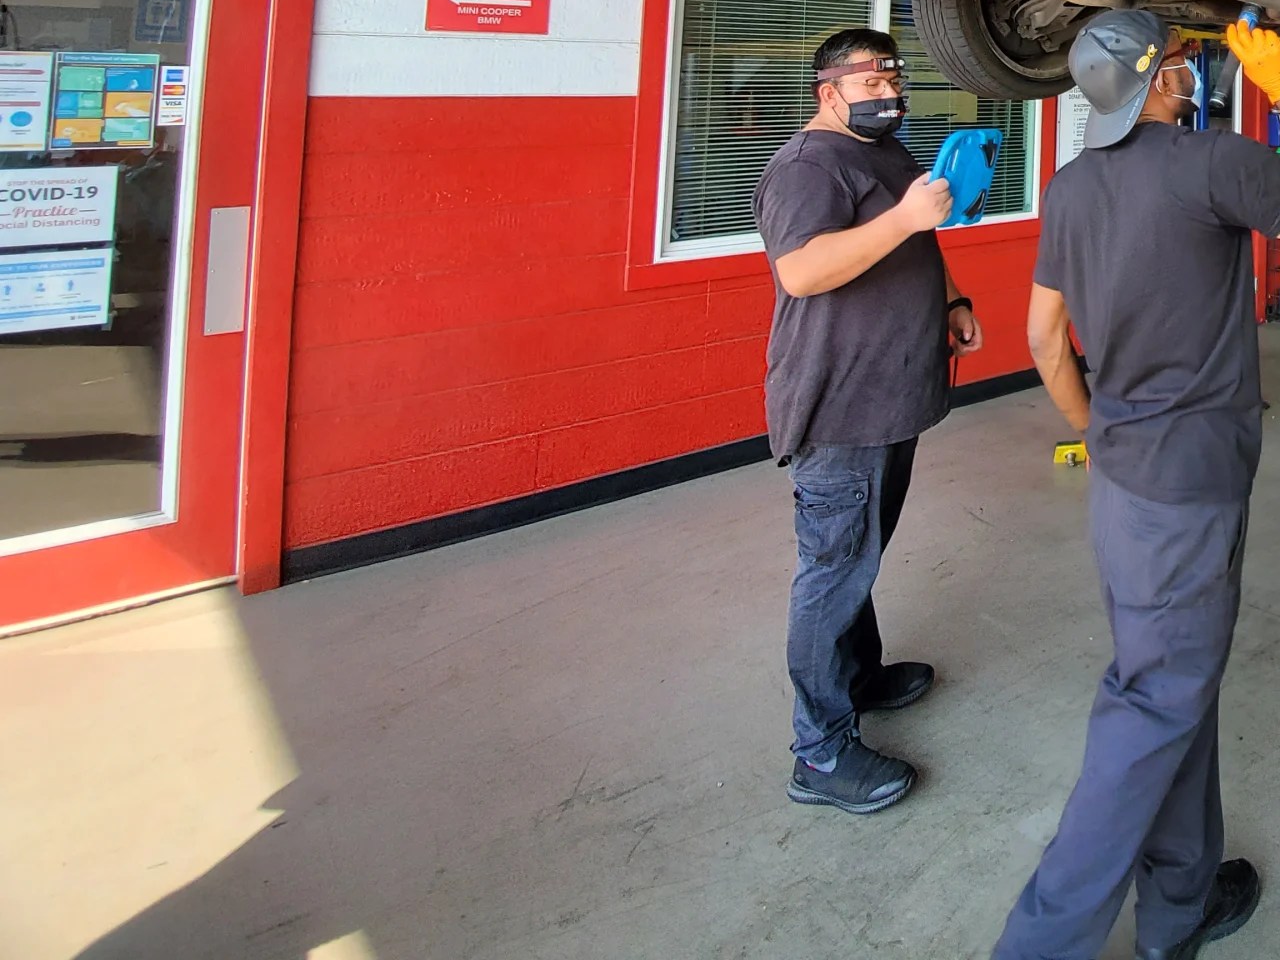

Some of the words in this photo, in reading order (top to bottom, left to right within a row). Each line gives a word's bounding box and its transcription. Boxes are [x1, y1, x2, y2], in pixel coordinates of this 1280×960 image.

[457, 7, 479, 15] MINI
[480, 8, 522, 17] COOPER
[477, 16, 502, 25] BMW
[0, 185, 99, 202] COVID-19
[12, 205, 78, 219] Practice
[32, 217, 101, 228] Distancing
